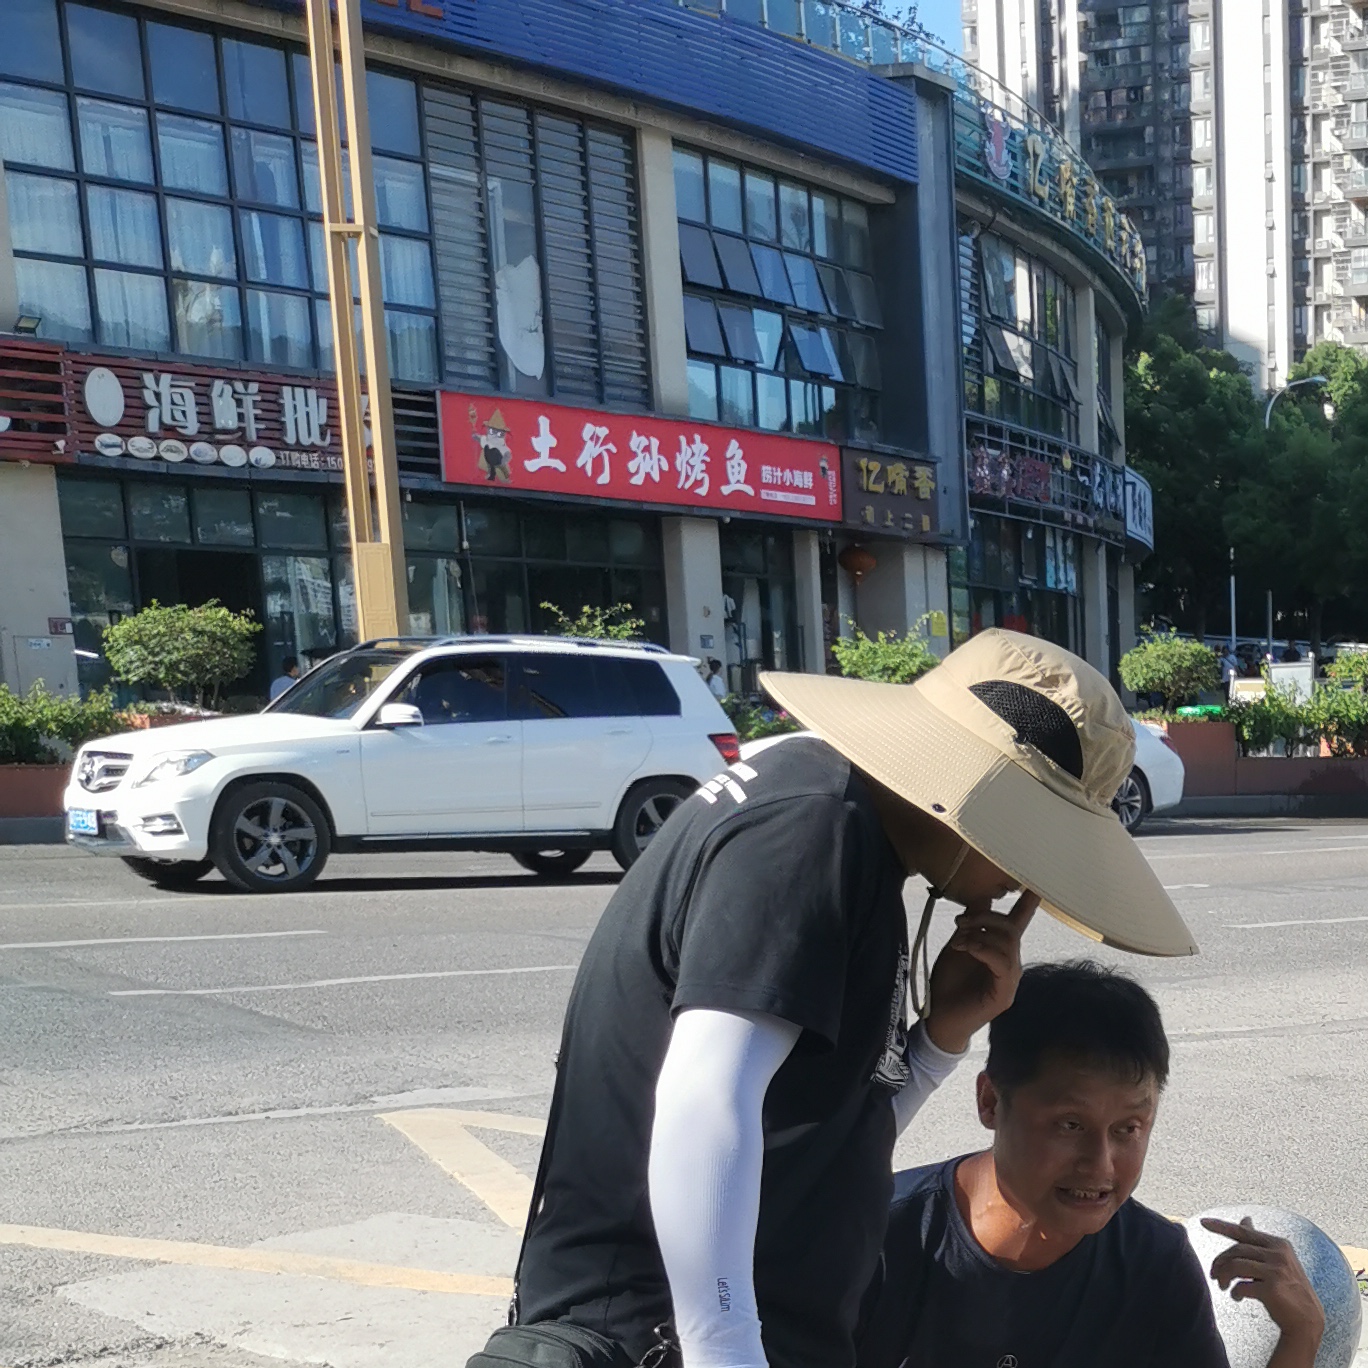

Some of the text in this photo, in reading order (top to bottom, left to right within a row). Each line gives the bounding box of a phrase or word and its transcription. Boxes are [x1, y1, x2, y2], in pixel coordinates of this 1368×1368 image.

[141, 371, 371, 448] 海鲜批
[523, 414, 755, 497] 土行孙烤鱼
